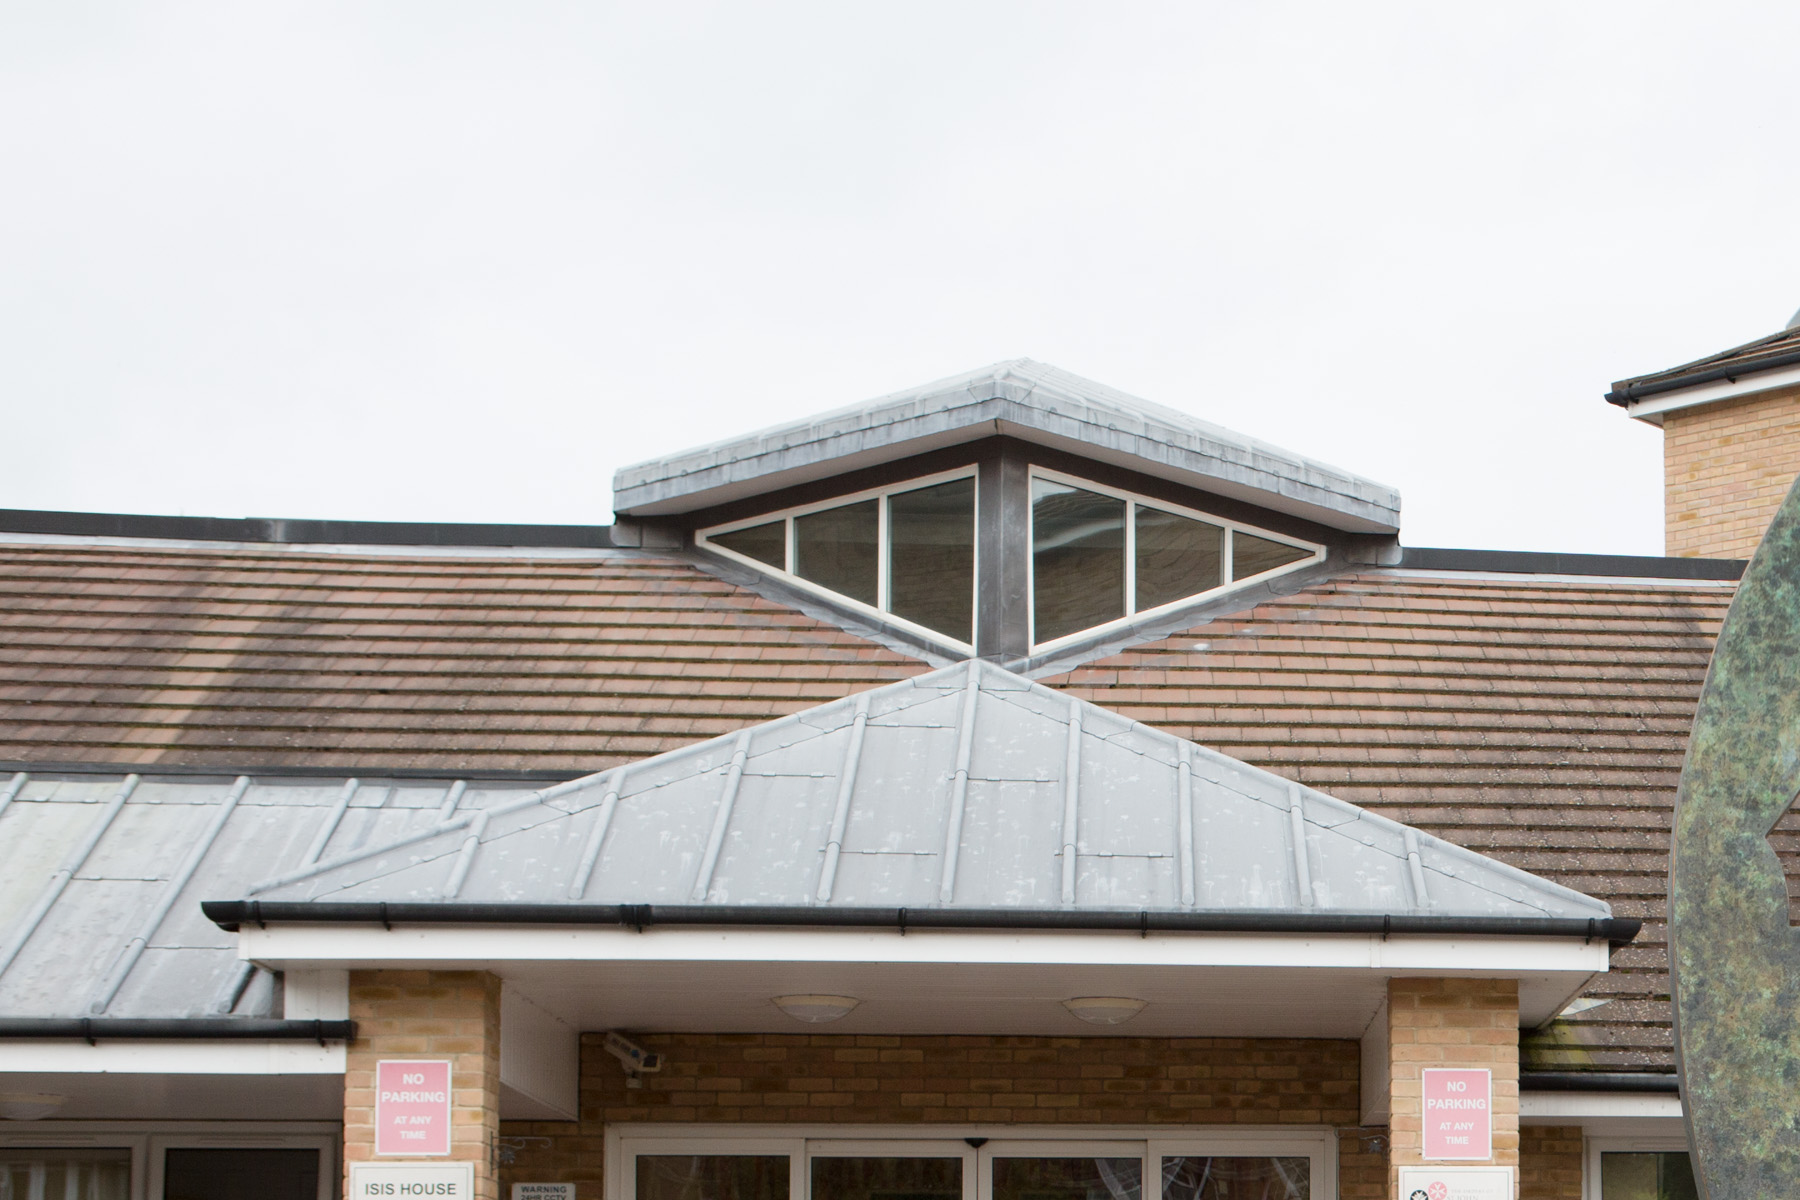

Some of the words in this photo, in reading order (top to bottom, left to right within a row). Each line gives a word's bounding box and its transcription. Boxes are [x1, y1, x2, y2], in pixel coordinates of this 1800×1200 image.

[403, 1073, 424, 1085] NO
[1446, 1081, 1467, 1092] NO
[381, 1091, 445, 1103] PARKING
[1427, 1098, 1486, 1110] PARKING
[394, 1116, 408, 1125] AT
[409, 1116, 432, 1125] ANY
[1439, 1122, 1452, 1131] AT
[1453, 1122, 1474, 1131] ANY
[400, 1131, 427, 1140] TIME
[1445, 1136, 1469, 1145] TIME
[365, 1183, 395, 1195] ISIS
[400, 1183, 457, 1195] HOUSE
[520, 1185, 567, 1193] WARNING
